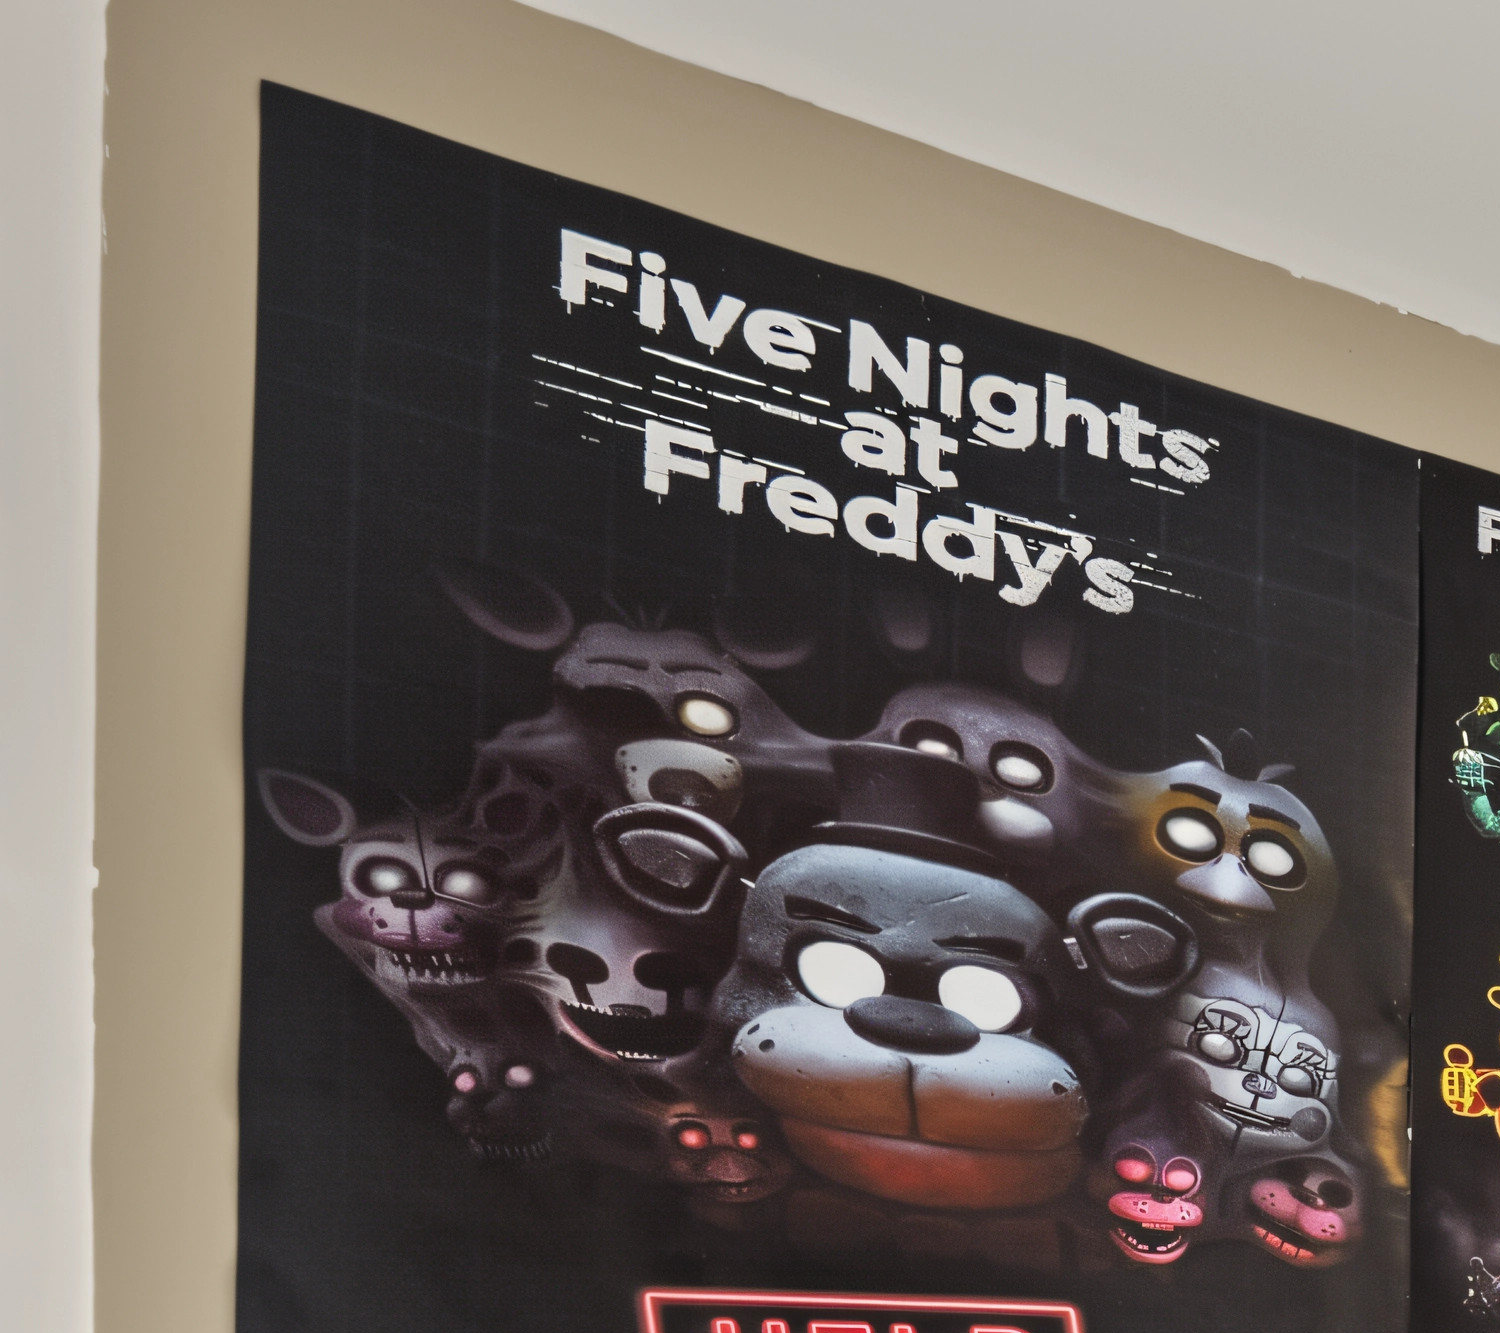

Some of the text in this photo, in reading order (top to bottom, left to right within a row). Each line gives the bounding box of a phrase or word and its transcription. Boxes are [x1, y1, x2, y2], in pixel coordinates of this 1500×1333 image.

[557, 229, 1214, 486] Five Nights
[840, 410, 960, 490] at
[643, 419, 1135, 617] Freddy's
